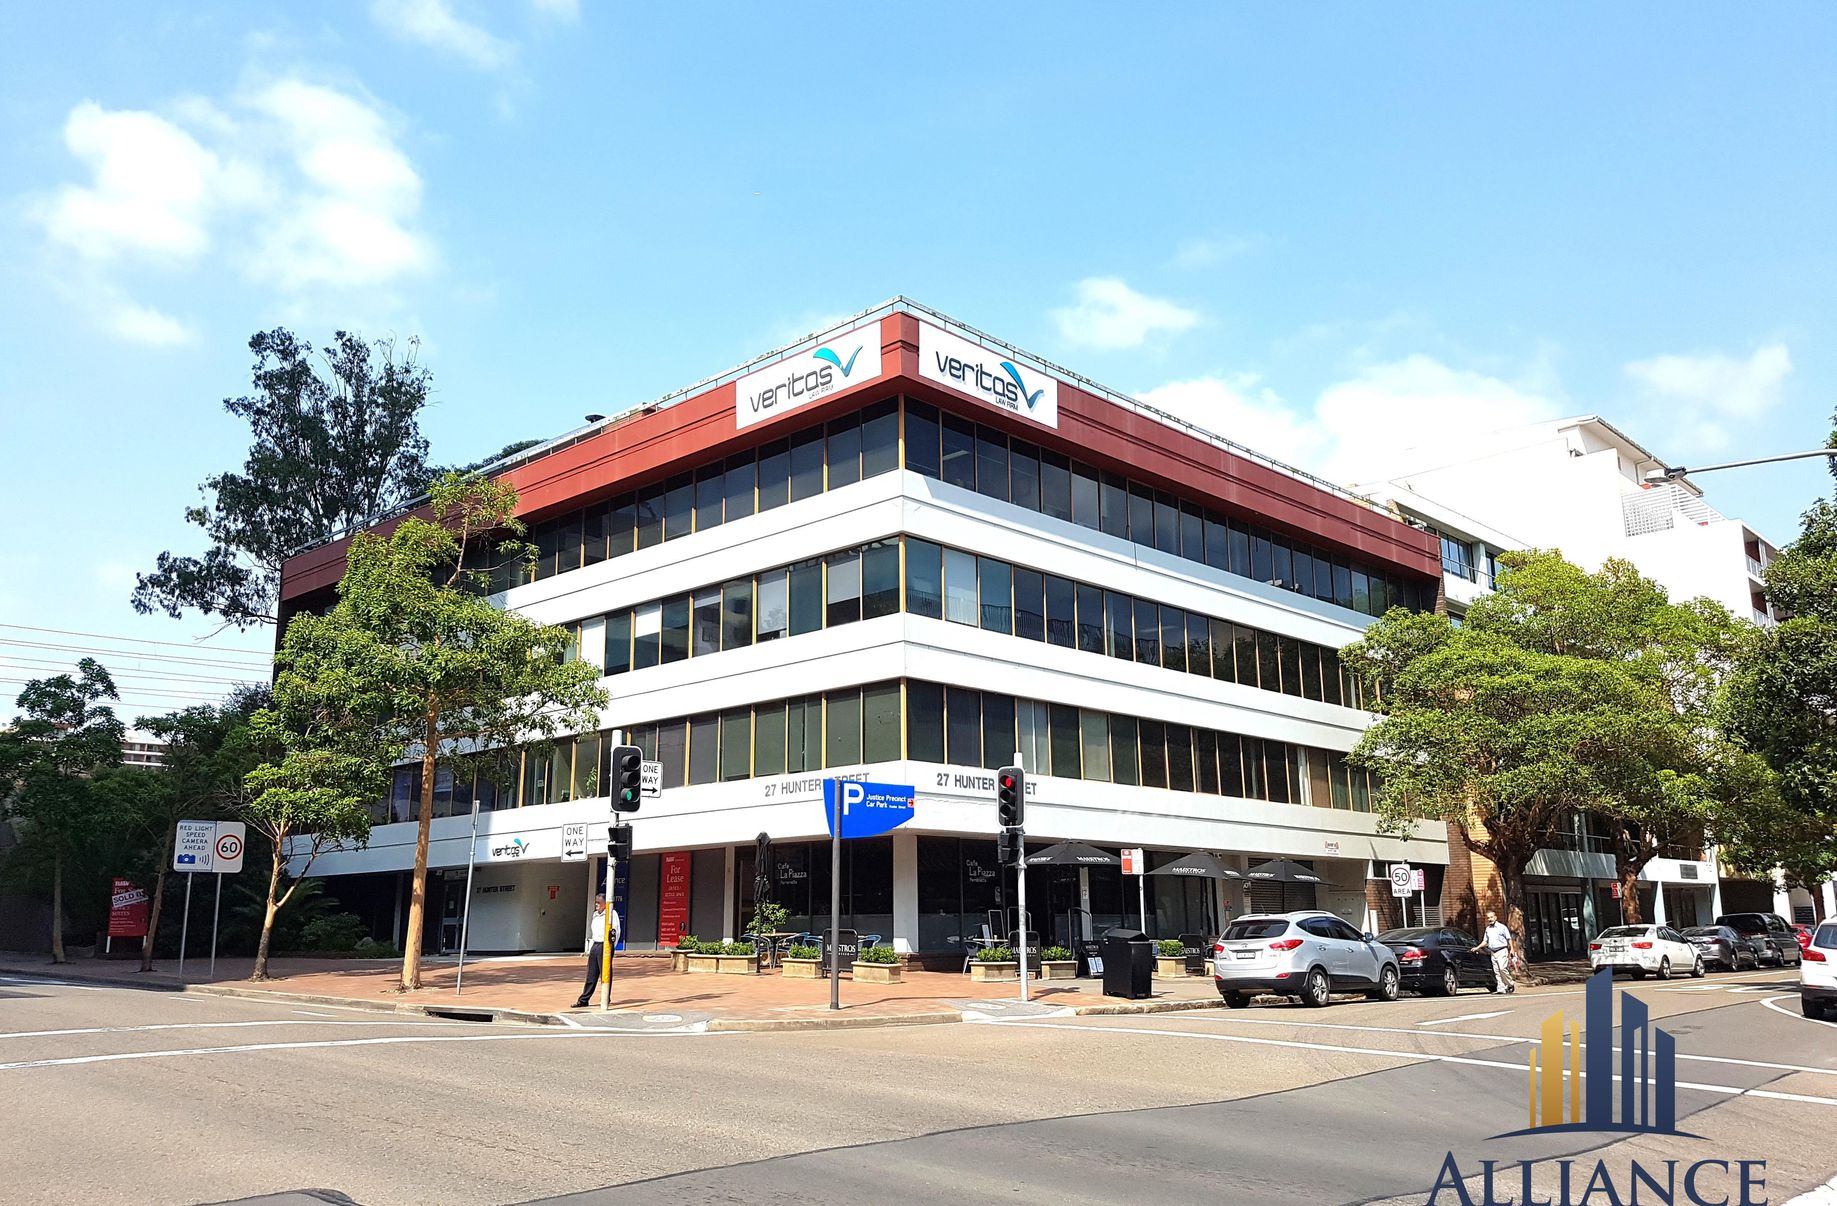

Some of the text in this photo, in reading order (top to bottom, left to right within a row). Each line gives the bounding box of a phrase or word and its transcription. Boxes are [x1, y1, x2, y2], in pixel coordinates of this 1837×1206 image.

[936, 351, 1018, 402] veritas
[750, 365, 833, 412] veritas
[809, 384, 834, 400] LAW FIRM
[995, 396, 1018, 411] LAW FIRM
[642, 765, 659, 774] ONE
[641, 775, 659, 785] WAY
[936, 773, 995, 791] 27 HUNTER
[765, 784, 777, 797] 27
[781, 778, 822, 794] HUNTER
[843, 782, 865, 815] P
[886, 795, 907, 803] Precinct
[566, 826, 584, 836] ONE
[221, 842, 238, 853] 60
[564, 838, 585, 847] WAY
[670, 864, 681, 874] For
[777, 862, 790, 870] Cafe
[969, 866, 996, 877] La Piazza
[666, 874, 684, 883] Lease
[780, 868, 807, 879] La Piazza
[1394, 872, 1408, 882] 50
[113, 893, 134, 904] SOLD
[826, 944, 856, 952] MSTROS
